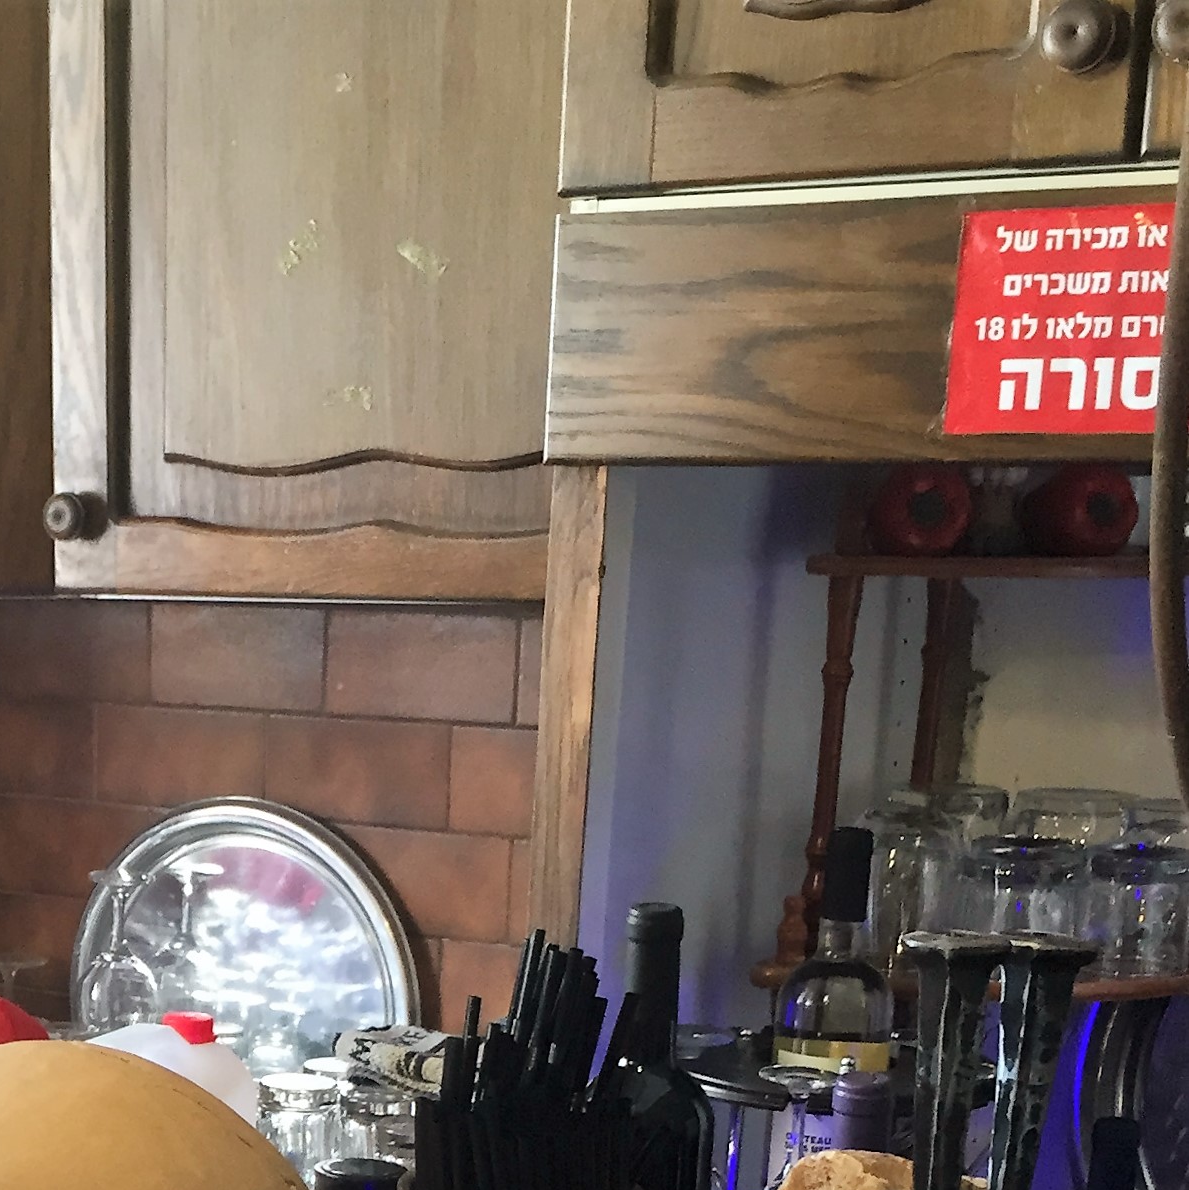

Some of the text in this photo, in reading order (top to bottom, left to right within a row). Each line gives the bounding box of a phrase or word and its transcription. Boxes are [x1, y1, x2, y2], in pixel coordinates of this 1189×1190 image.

[996, 222, 1168, 253] או מכירה של
[1002, 271, 1112, 297] משכרים
[974, 316, 1005, 341] 18
[1010, 312, 1038, 340] לו
[1045, 311, 1113, 339] מלאו
